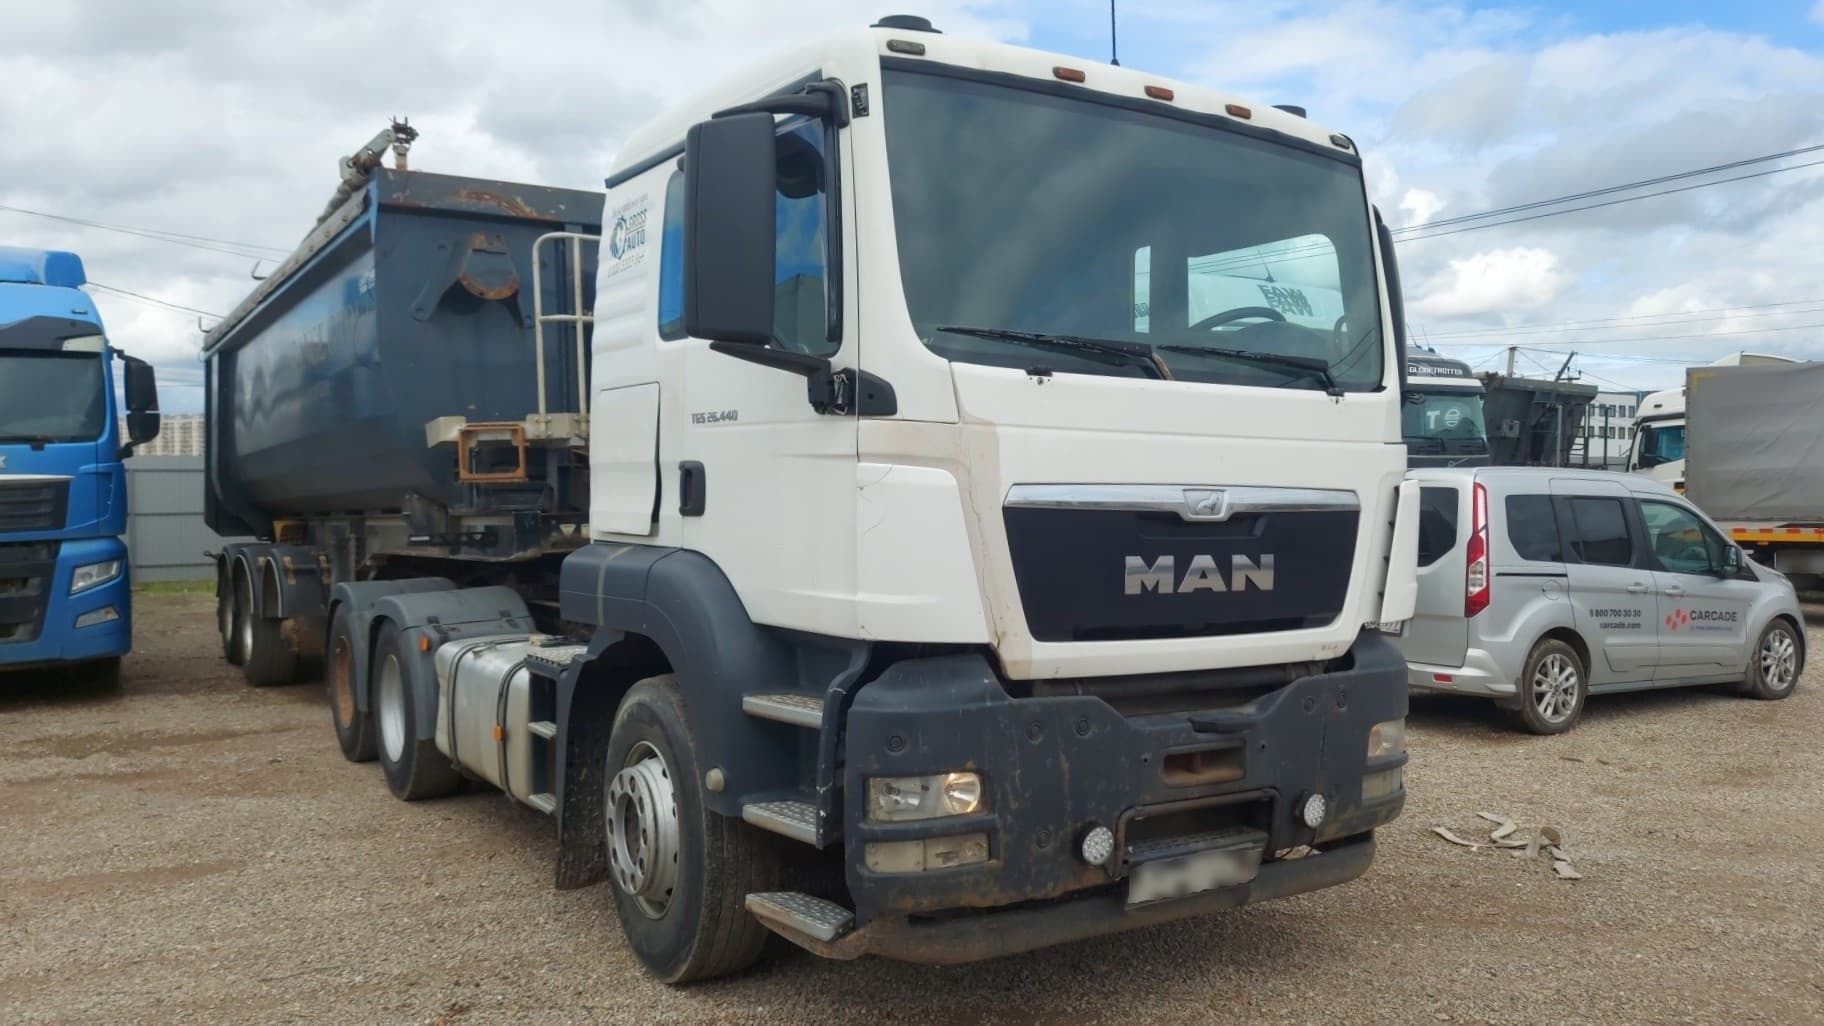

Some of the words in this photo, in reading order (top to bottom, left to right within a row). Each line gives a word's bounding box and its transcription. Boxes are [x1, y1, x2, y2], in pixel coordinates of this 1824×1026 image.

[626, 228, 646, 251] AUTO
[1124, 553, 1275, 595] MAN
[1690, 610, 1737, 622] CARCADE
